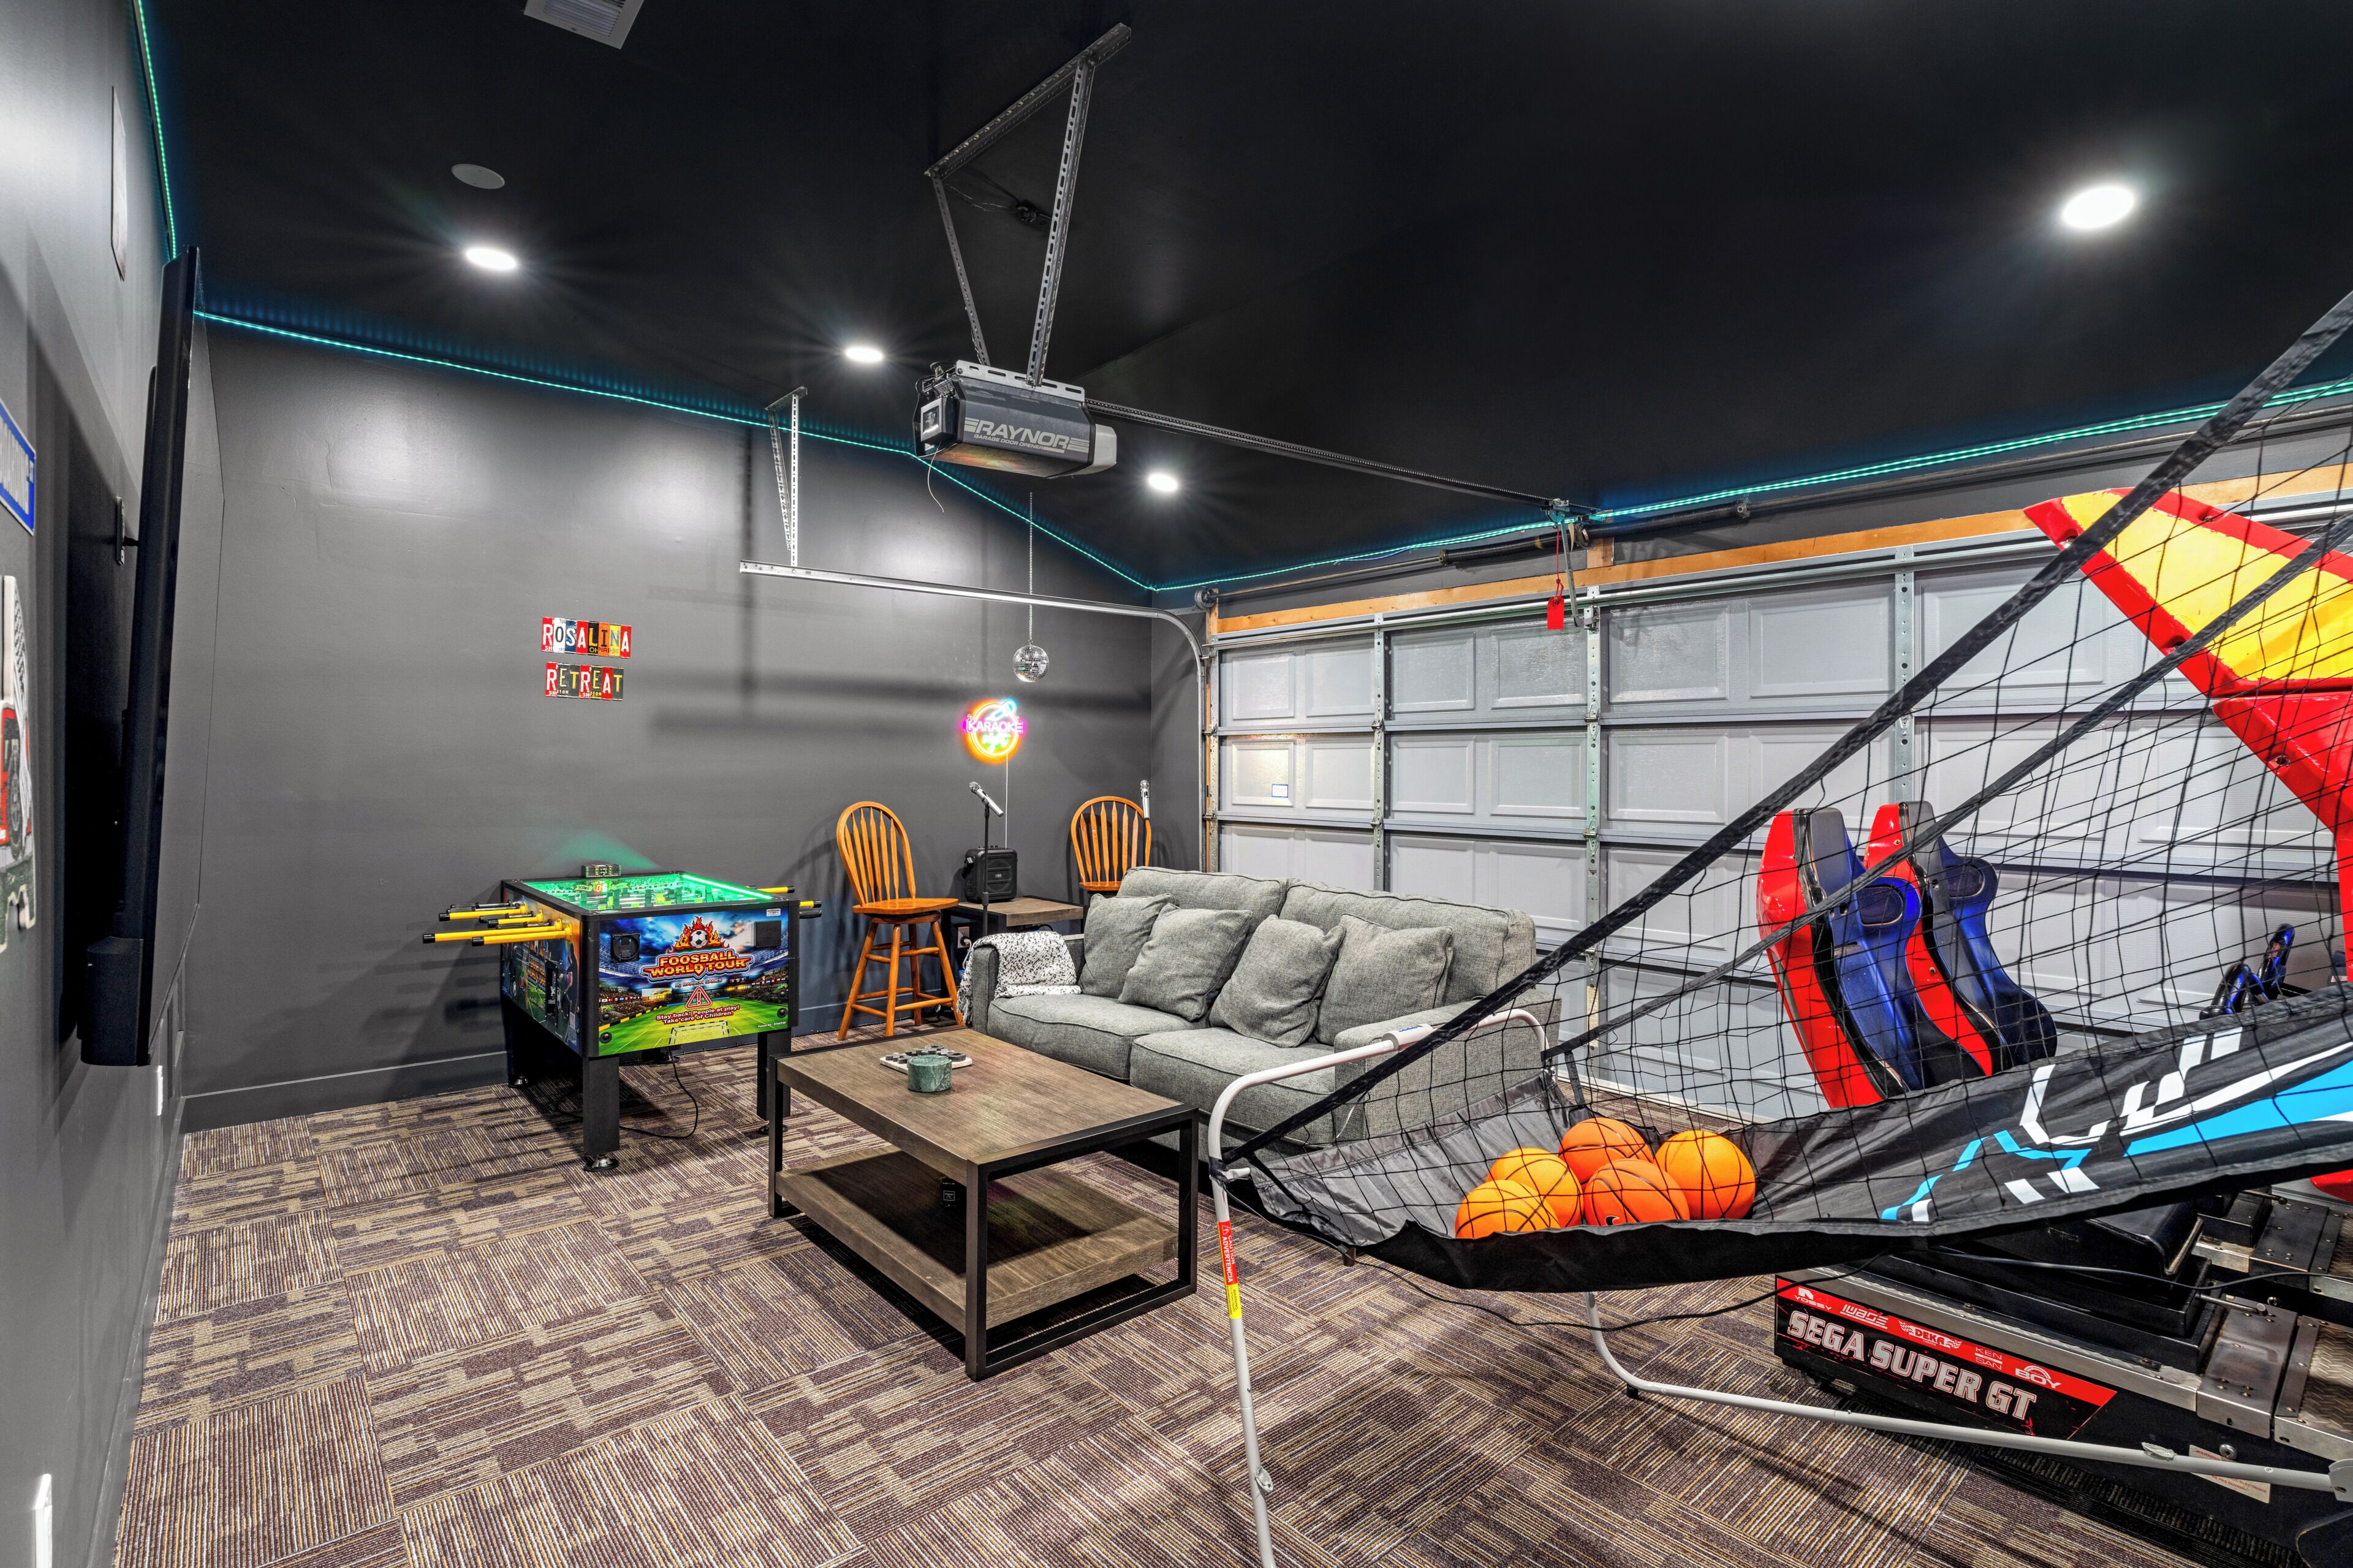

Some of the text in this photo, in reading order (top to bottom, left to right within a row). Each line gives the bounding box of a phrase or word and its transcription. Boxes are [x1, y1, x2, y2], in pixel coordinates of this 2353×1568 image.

[974, 434, 1000, 442] GARAGE
[975, 420, 1070, 449] RAYNOR
[543, 624, 629, 653] ROSALINA
[547, 668, 623, 694] RETREAT
[968, 721, 1022, 733] KARAOKE
[660, 950, 735, 966] FOOSBALL
[651, 959, 746, 975] WORLD TOUR
[1222, 1236, 1233, 1283] ADVERTENCIA
[1794, 1295, 1832, 1311] YOSSY
[1915, 1328, 1944, 1345] DEKA
[1976, 1347, 2002, 1360] KEN
[1787, 1310, 2036, 1420] SEGA SUPER GT
[1975, 1357, 2002, 1370] SAN
[2015, 1368, 2062, 1389] BOY
